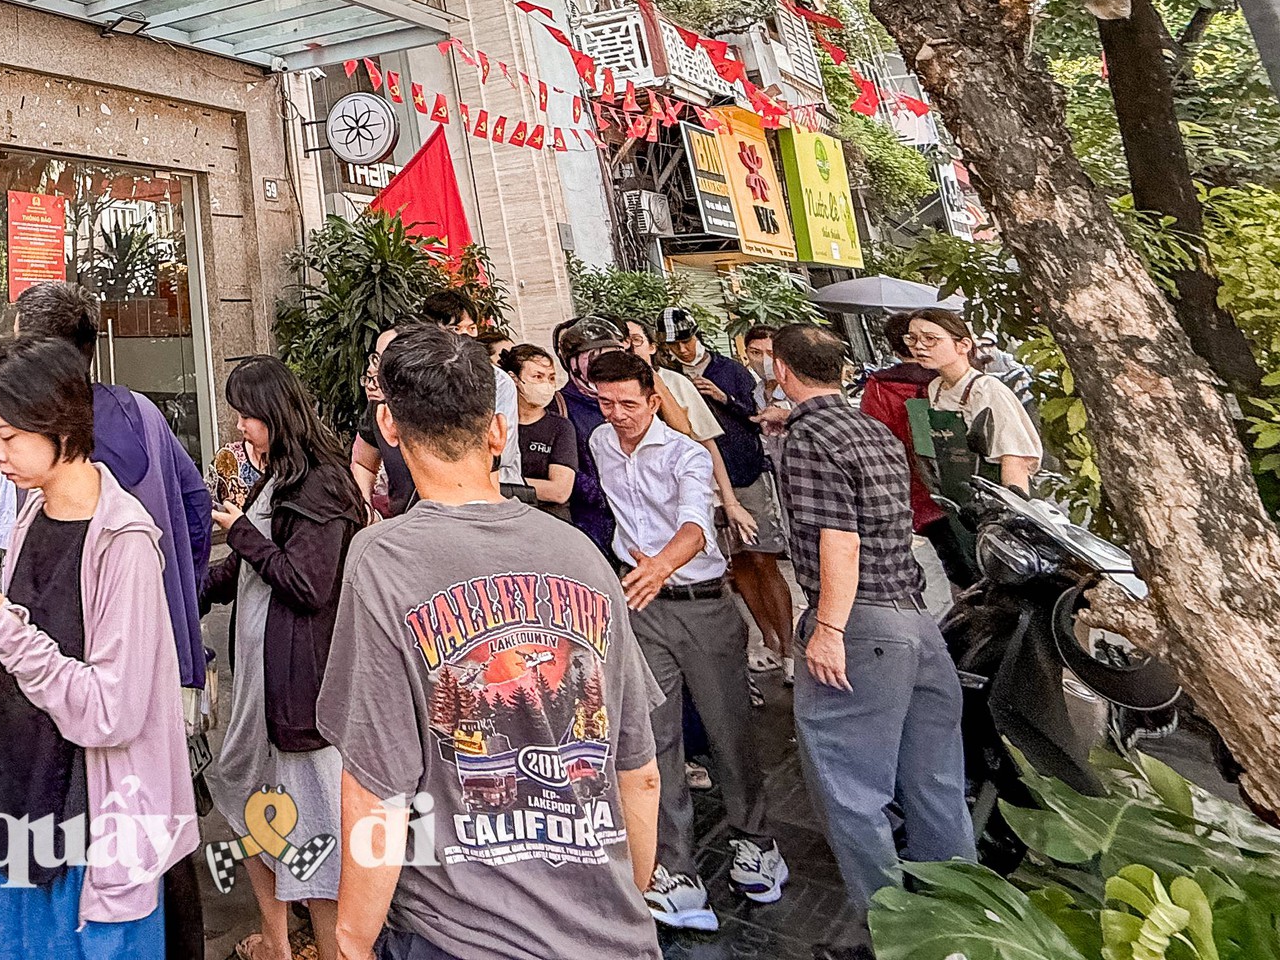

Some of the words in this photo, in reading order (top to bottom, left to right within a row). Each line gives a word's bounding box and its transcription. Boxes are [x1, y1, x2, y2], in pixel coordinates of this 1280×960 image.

[266, 180, 277, 197] 59
[407, 573, 540, 671] VALLEY
[545, 574, 611, 662] FIRE
[490, 635, 516, 652] LAKE
[516, 632, 557, 647] COUNTY
[528, 796, 576, 815] LAKEPORT
